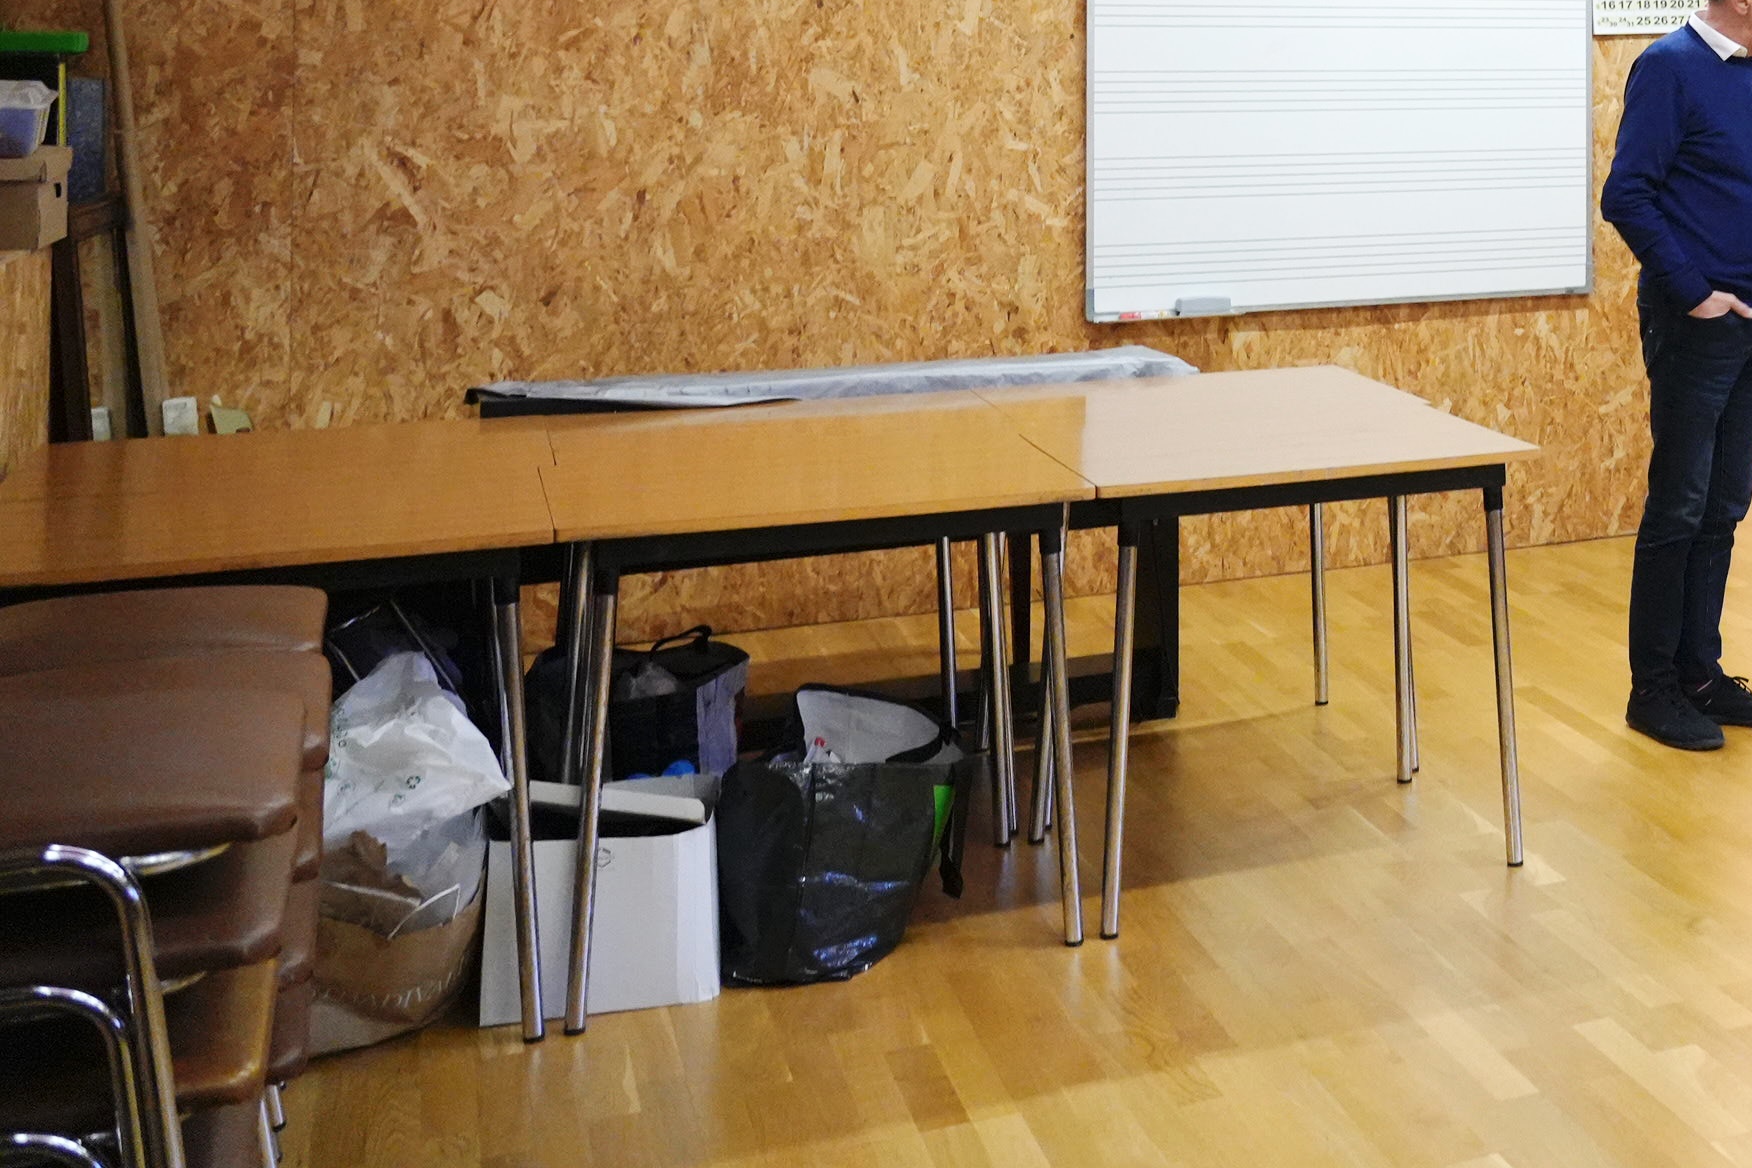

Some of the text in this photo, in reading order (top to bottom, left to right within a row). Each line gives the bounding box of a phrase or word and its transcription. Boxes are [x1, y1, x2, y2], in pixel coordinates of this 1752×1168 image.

[1602, 0, 1616, 10] 16
[1619, 0, 1632, 10] 17
[1637, 0, 1650, 9] 18
[1654, 0, 1667, 9] 19
[1670, 0, 1684, 9] 20
[1687, 0, 1701, 8] 21
[1636, 16, 1651, 26] 25
[1653, 16, 1668, 25] 26
[1671, 15, 1685, 25] 27
